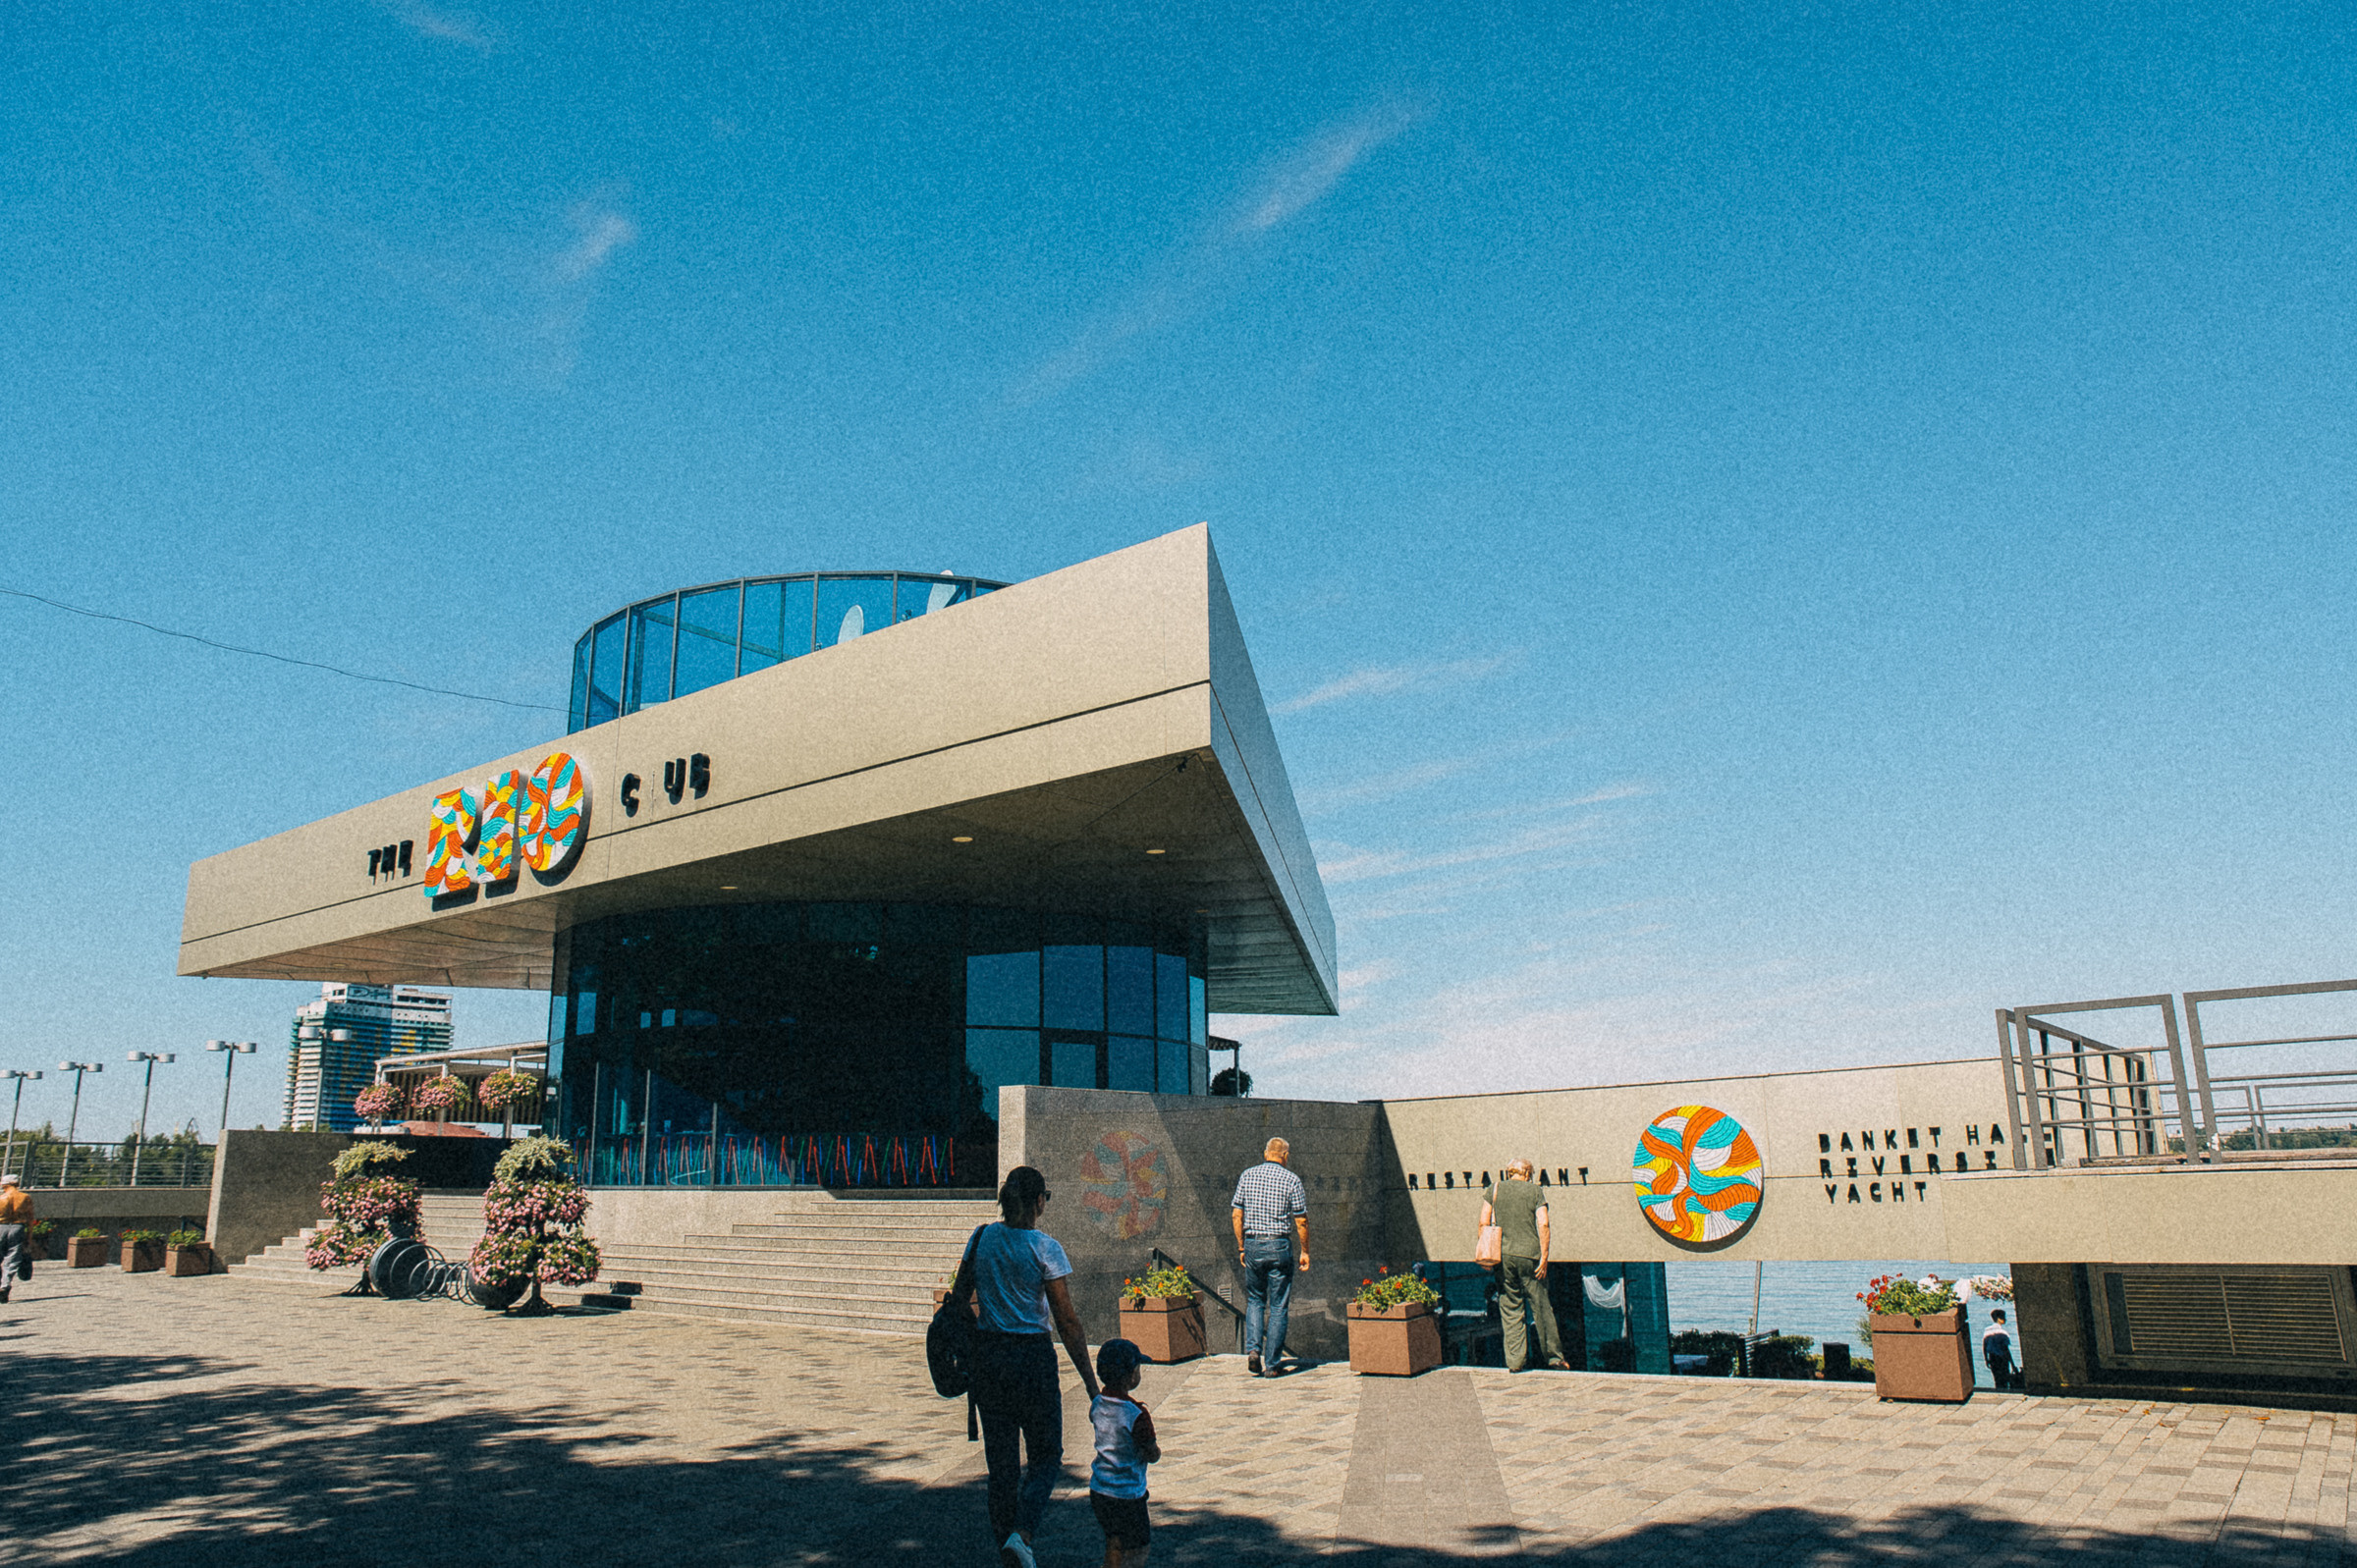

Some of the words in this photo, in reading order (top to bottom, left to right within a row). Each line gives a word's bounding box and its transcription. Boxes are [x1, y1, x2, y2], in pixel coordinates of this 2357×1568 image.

[366, 839, 413, 886] THE
[423, 752, 589, 899] RIO
[1818, 1126, 1942, 1154] BANKET
[1408, 1166, 1588, 1191] RESTAUANT
[1825, 1181, 1927, 1204] YACHT
